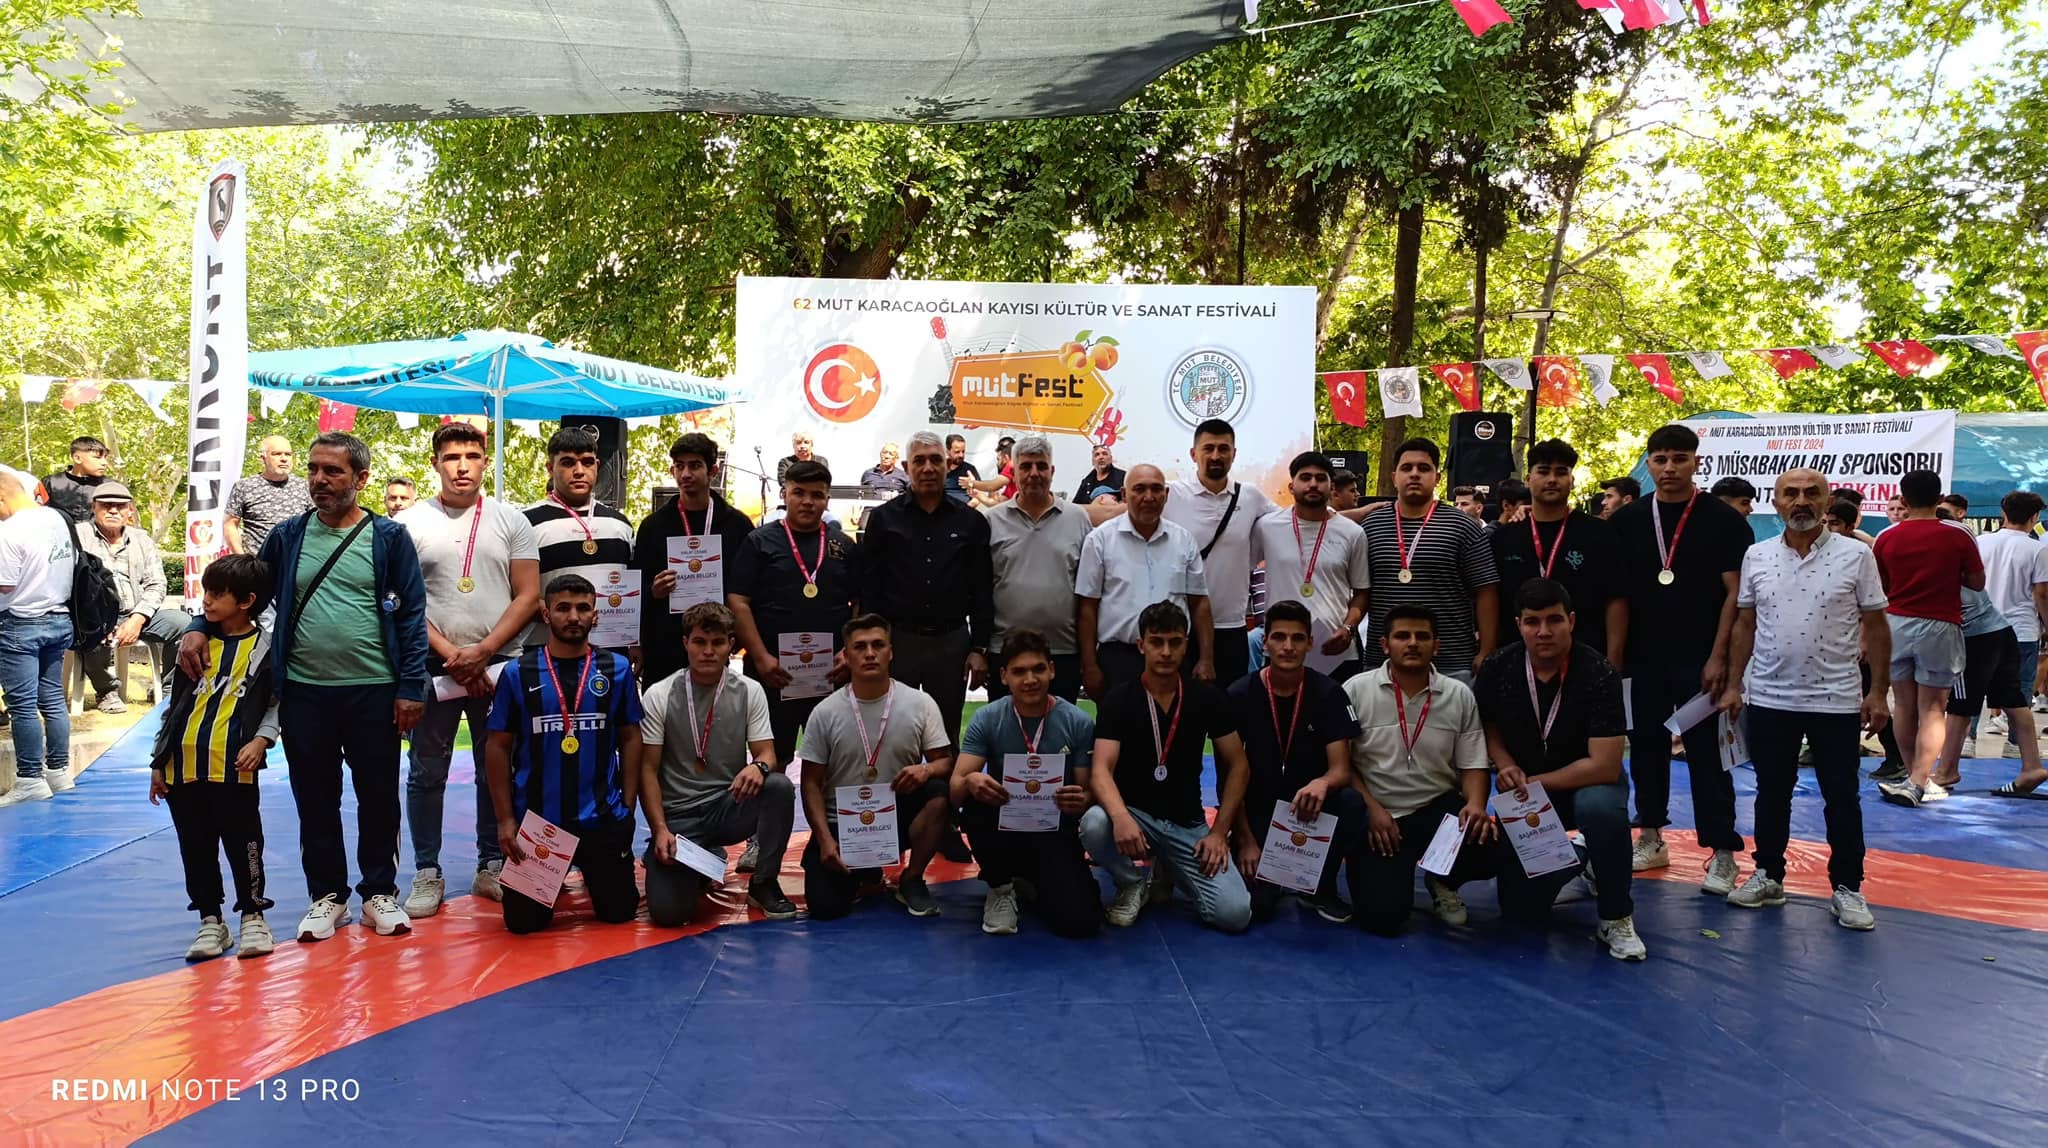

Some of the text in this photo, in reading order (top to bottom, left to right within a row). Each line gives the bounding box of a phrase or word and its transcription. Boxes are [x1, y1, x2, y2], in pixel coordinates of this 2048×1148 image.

[793, 298, 1276, 317] 62 MUT KARACAOĞLAN KAYISI KÜLTÜR VE SANAT FESTİVALİ
[1199, 376, 1217, 384] MUT
[1709, 426, 1726, 438] MUT
[1726, 423, 1776, 437] KARACAOĞLAN
[1776, 424, 1801, 436] KAYISI
[1802, 421, 1831, 436] KÜLTÜR
[1833, 423, 1843, 435] VE
[1845, 421, 1871, 434] SANAT
[1872, 417, 1913, 434] FESTİVALİ
[1766, 438, 1825, 450] MUT FEST 2024
[1839, 452, 1943, 476] SPONSORU
[596, 608, 615, 617] AŞARI
